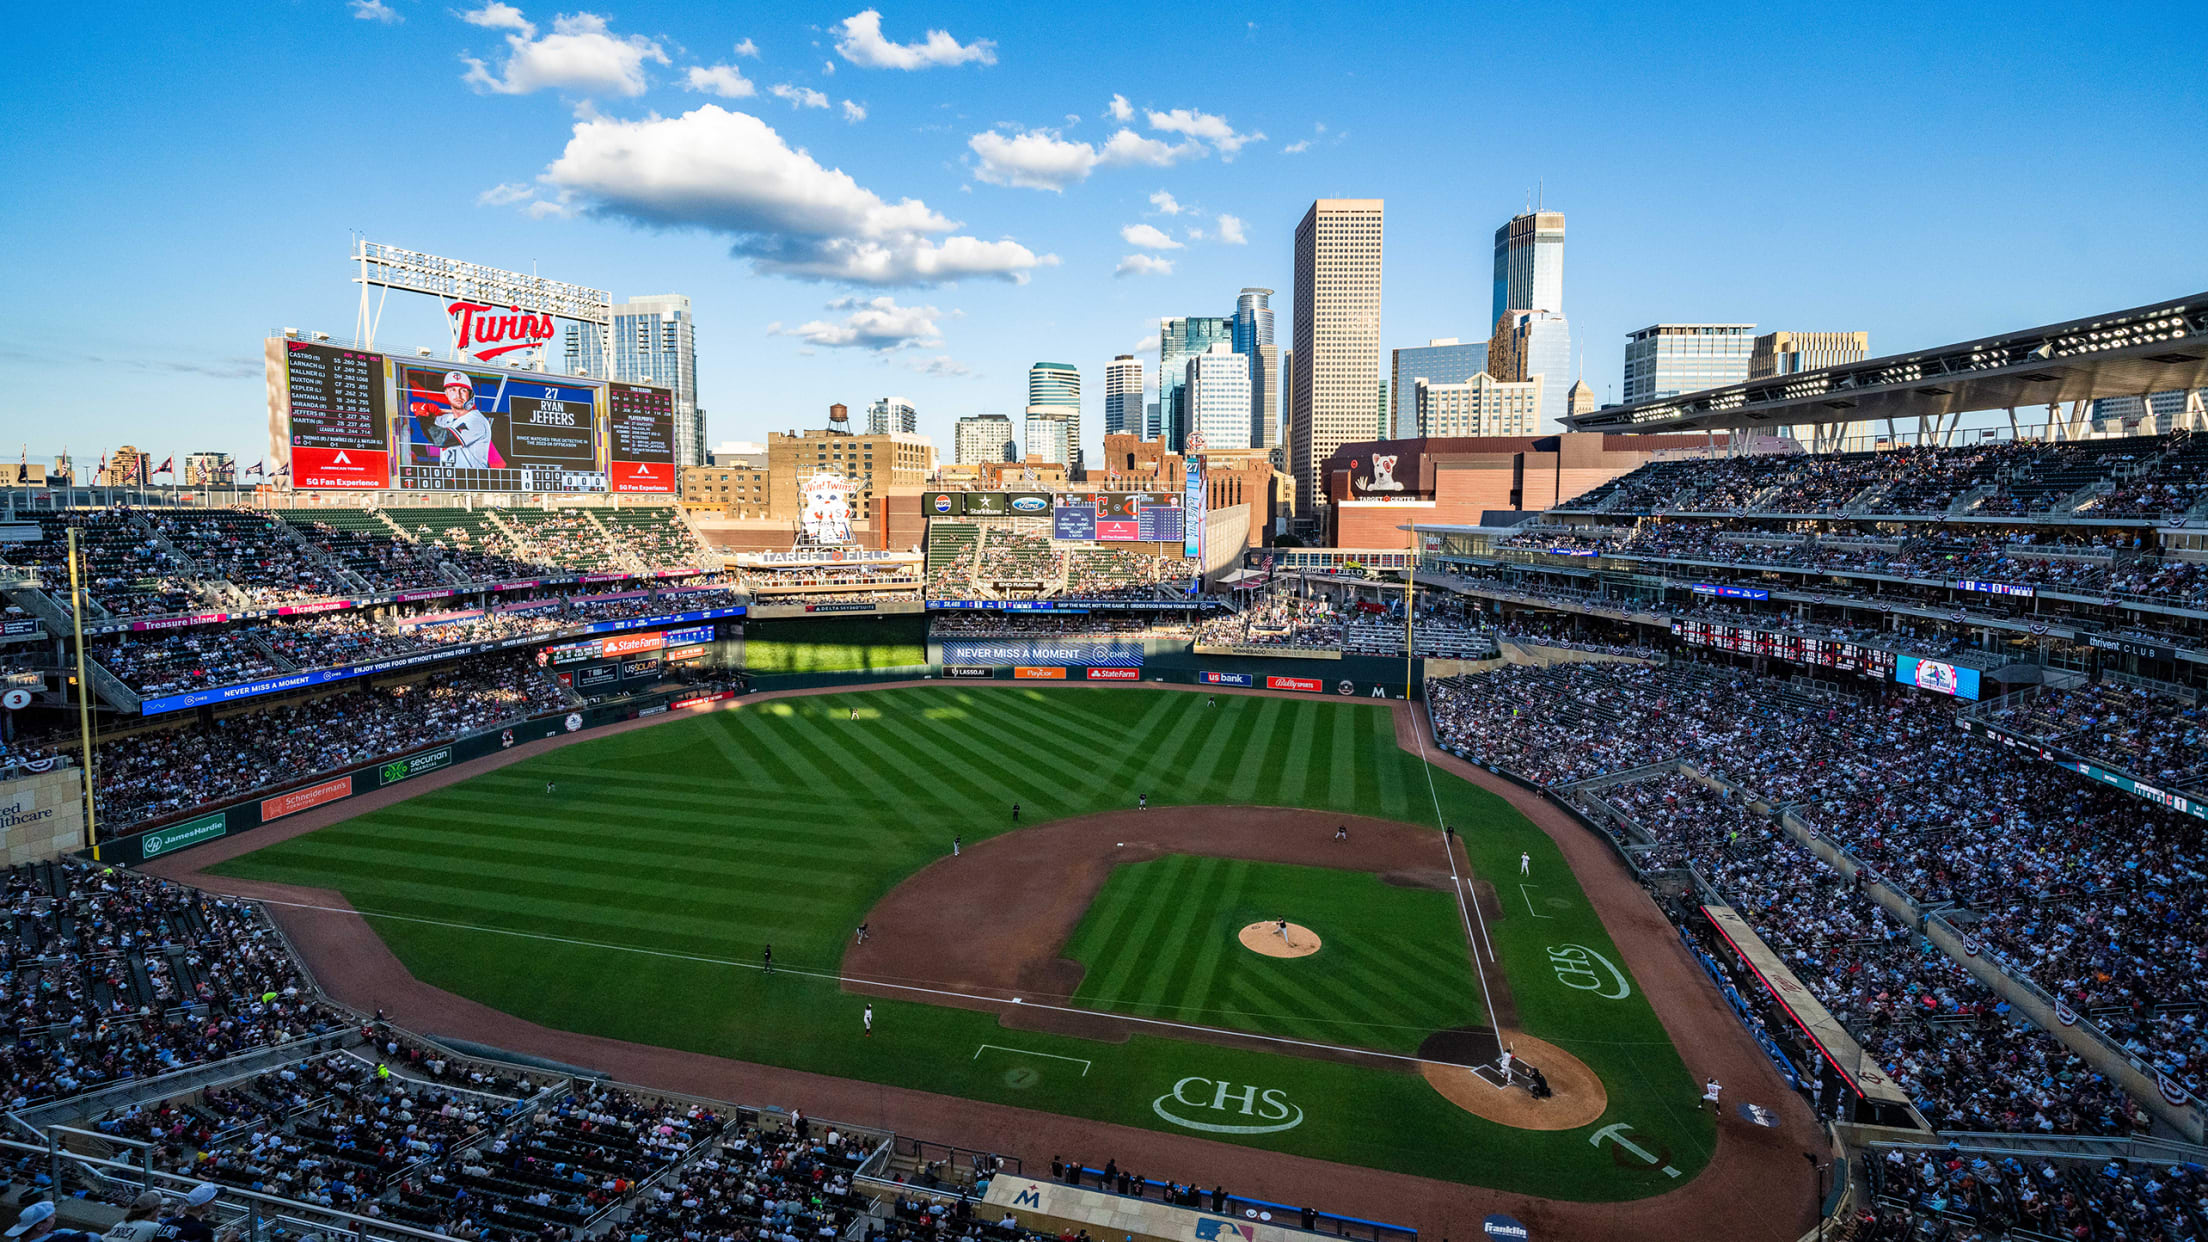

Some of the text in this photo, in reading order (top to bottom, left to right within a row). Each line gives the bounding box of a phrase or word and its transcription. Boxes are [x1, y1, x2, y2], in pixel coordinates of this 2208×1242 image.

[448, 302, 554, 349] Twins
[290, 360, 318, 368] LARNACH
[290, 368, 318, 376] WALLNER
[291, 392, 319, 401] SANTANA
[545, 387, 558, 400] 27
[292, 401, 319, 409] MIRANDA
[541, 400, 564, 412] RYAN
[293, 409, 318, 417] JEFFERS
[530, 410, 575, 425] JEFFERS
[1187, 463, 1198, 473] 27
[336, 479, 379, 487] Experience
[803, 480, 825, 492] Win!
[1019, 500, 1039, 509] Ford
[766, 551, 890, 562] TARGET FIELD
[584, 575, 606, 584] Treasure
[404, 590, 448, 601] Treasure Island
[542, 606, 559, 614] Deck
[144, 614, 218, 630] Treasure Island
[502, 638, 517, 648] NEVER
[517, 637, 527, 645] MISS
[532, 633, 550, 642] MOMENT
[2090, 637, 2155, 658] thrivent CLUB
[957, 649, 991, 658] NEVER
[994, 649, 1019, 658] MISS
[1023, 650, 1030, 658] A
[1033, 650, 1079, 659] MOMENT
[354, 664, 373, 674] ENJOY
[375, 662, 391, 671] YOUR
[391, 658, 407, 667] FOOD
[408, 654, 431, 665] WITHOUT
[432, 650, 454, 660] WAITING
[455, 648, 466, 656] FOR
[1027, 669, 1053, 677] Paycor
[1208, 672, 1243, 683] us bank
[224, 676, 310, 698] NEVER MISS A MOMENT
[1275, 679, 1298, 689] Bally
[13, 694, 22, 704] 3
[409, 750, 448, 768] securian
[410, 760, 437, 773] FINANCIAL
[285, 781, 347, 807] Schneiderman's
[2166, 795, 2172, 805] C
[164, 821, 223, 845] JamesHardie
[1546, 943, 1602, 993] CHS
[1172, 1076, 1290, 1120] CHS
[1484, 1222, 1526, 1236] Franklin
